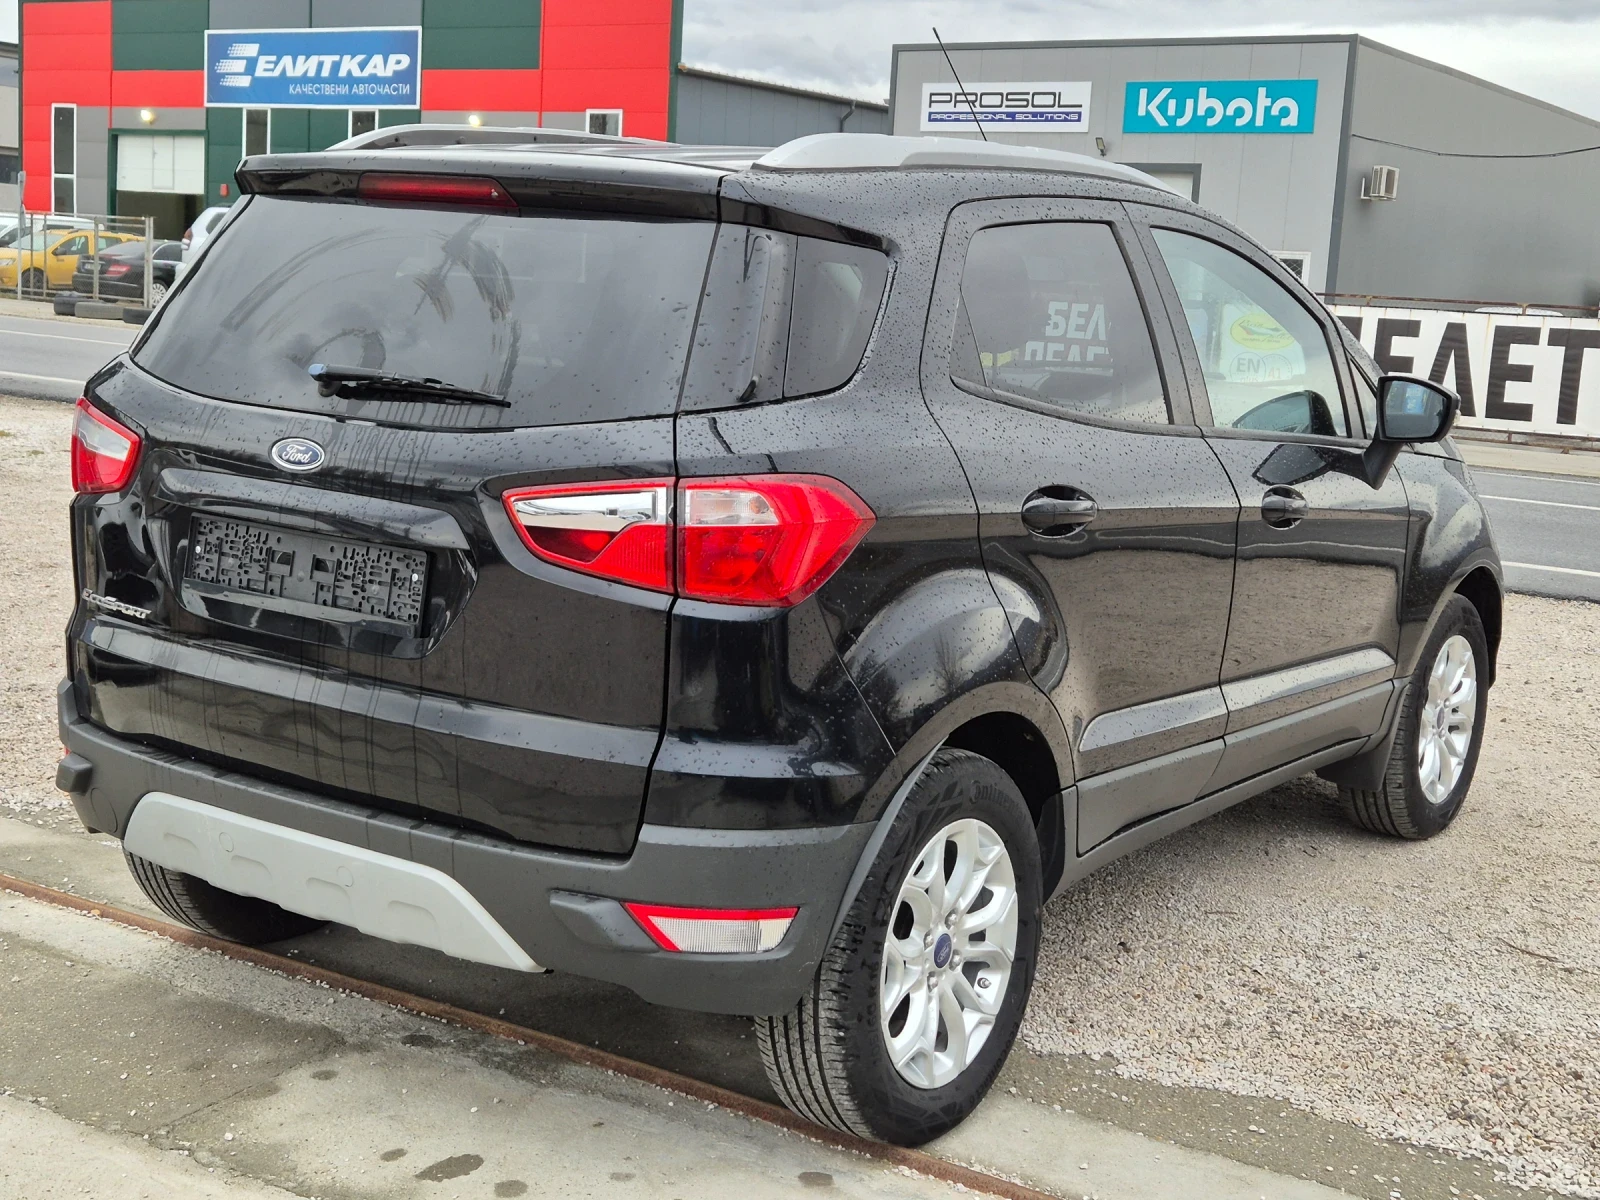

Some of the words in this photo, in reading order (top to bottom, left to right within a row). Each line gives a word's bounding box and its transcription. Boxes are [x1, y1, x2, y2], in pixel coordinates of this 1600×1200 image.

[289, 83, 349, 95] КАЧЕСТВЕНИ
[351, 83, 410, 95] АВТОЧАСТИ
[928, 92, 1083, 109] PROSOL
[1138, 87, 1299, 126] Kubota
[930, 113, 1012, 121] PROFESSIONAL
[1015, 113, 1079, 121] SOLUTIONS
[1236, 357, 1261, 374] EN
[1337, 315, 1600, 426] ЕЛЕТ
[281, 444, 313, 463] Ford
